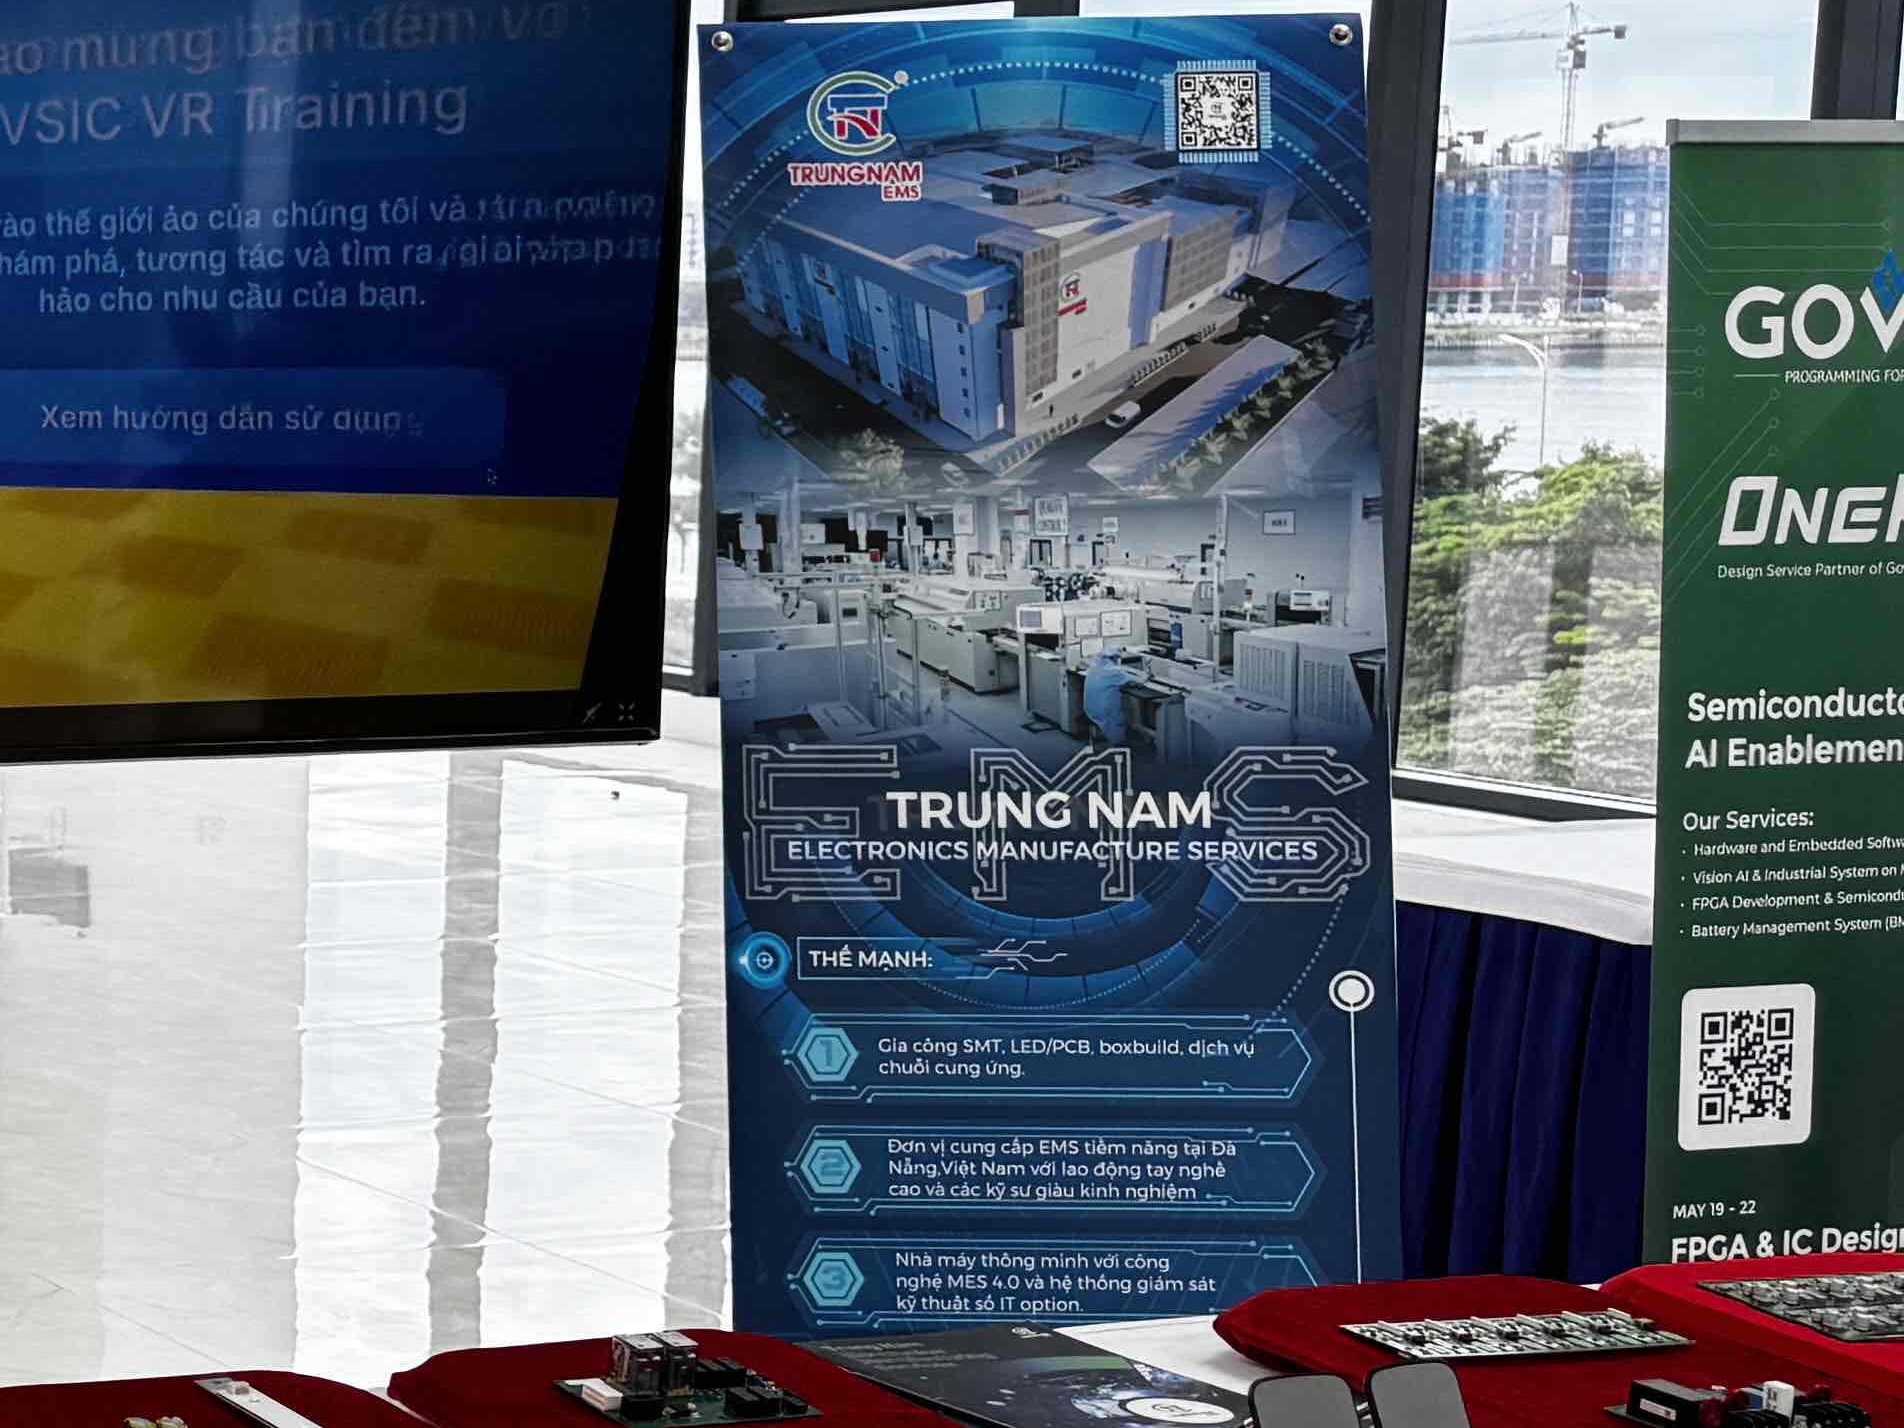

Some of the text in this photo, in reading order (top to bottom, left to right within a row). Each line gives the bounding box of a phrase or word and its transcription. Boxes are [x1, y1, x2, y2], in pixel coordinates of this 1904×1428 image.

[142, 89, 215, 140] VR
[236, 78, 470, 136] Training
[789, 163, 922, 184] TRUNGNAM
[882, 185, 921, 201] EMS
[46, 207, 92, 236] thế
[100, 206, 152, 240] giới
[162, 204, 198, 232] ảo
[207, 199, 262, 230] của
[272, 199, 368, 232] chúng
[380, 196, 418, 225] tôi
[65, 247, 126, 279] phá,
[137, 247, 227, 274] tương
[237, 241, 285, 269] tác
[296, 240, 331, 268] và
[342, 237, 391, 265] tìm
[39, 280, 426, 314] hảo cho nhu của bạn.
[1785, 370, 1880, 383] PROGRAMMING
[41, 400, 273, 436] Xem hướng dẫn
[1718, 562, 1865, 580] Design Service Partner
[1685, 734, 1904, 768] AI Enablemen
[886, 790, 1213, 830] TRUNG NAM
[1683, 808, 1814, 831] Our Services:
[788, 840, 1318, 861] ELECTRONICS MANUFACTURE SERVICES
[1694, 838, 1863, 856] Hardware and Embedded
[1693, 866, 1878, 884] Vision Industrial System
[1692, 893, 1820, 910] FPGA Development
[1692, 918, 1881, 939] Battery Management System
[808, 944, 933, 972] THẾ MẠNH:
[879, 1037, 1228, 1057] Gia công SMT, LED/PCB, boxbuild, dịch
[879, 1058, 1024, 1078] chuỗi cung ứng.
[888, 1136, 1205, 1159] Đơn cung cấp EMS tiềm năng tại
[982, 1161, 1226, 1180] Nam với lao động tay nghề
[889, 1182, 1196, 1203] cao các kinh nghiệm
[1673, 1200, 1756, 1219] MAY 19 22
[1672, 1228, 1812, 1264] FPGA & IC
[896, 1252, 1169, 1272] Nhà máy thông minh với công
[896, 1275, 1216, 1293] nghệ MES 4.0 hệ thống giám sát
[922, 1295, 1084, 1314] thuật option.
